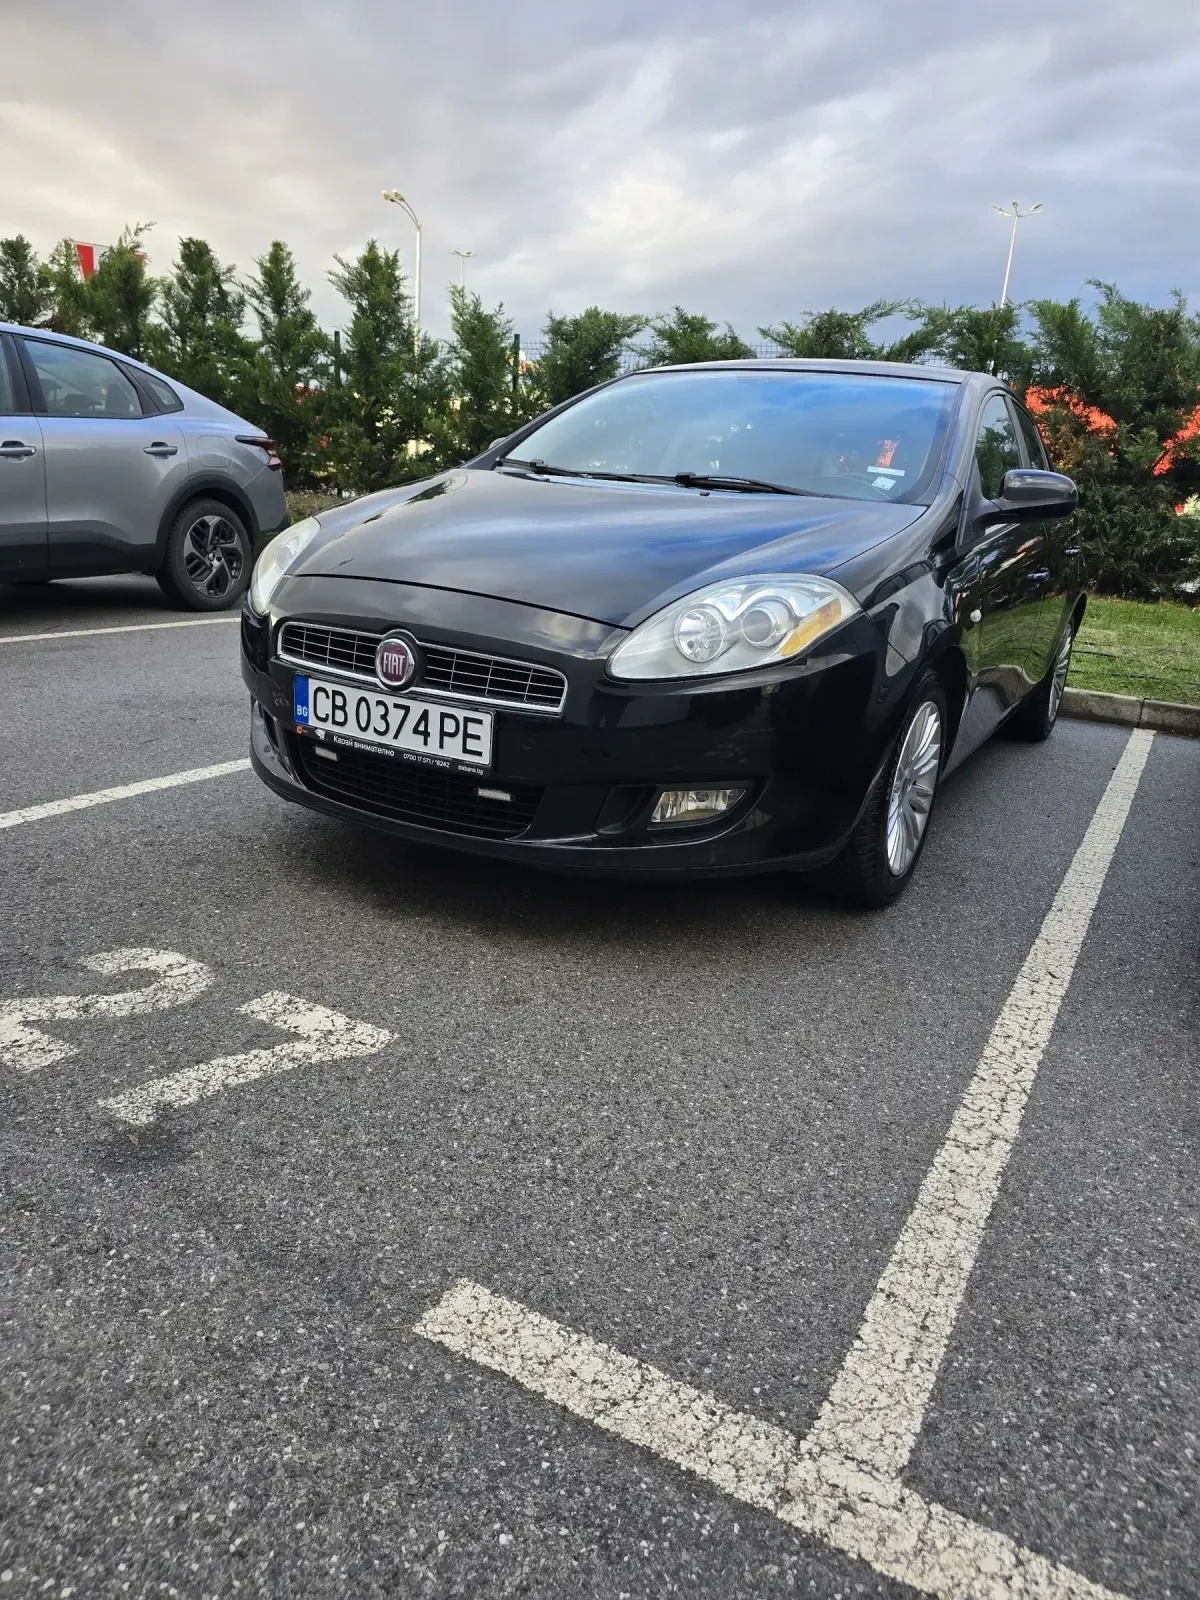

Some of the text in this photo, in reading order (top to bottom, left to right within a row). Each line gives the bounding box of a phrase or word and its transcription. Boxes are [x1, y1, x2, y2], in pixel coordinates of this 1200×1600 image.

[383, 651, 405, 674] FIAT
[296, 705, 308, 717] BG
[355, 696, 431, 746] 0374
[333, 735, 395, 757] Карай внимателно
